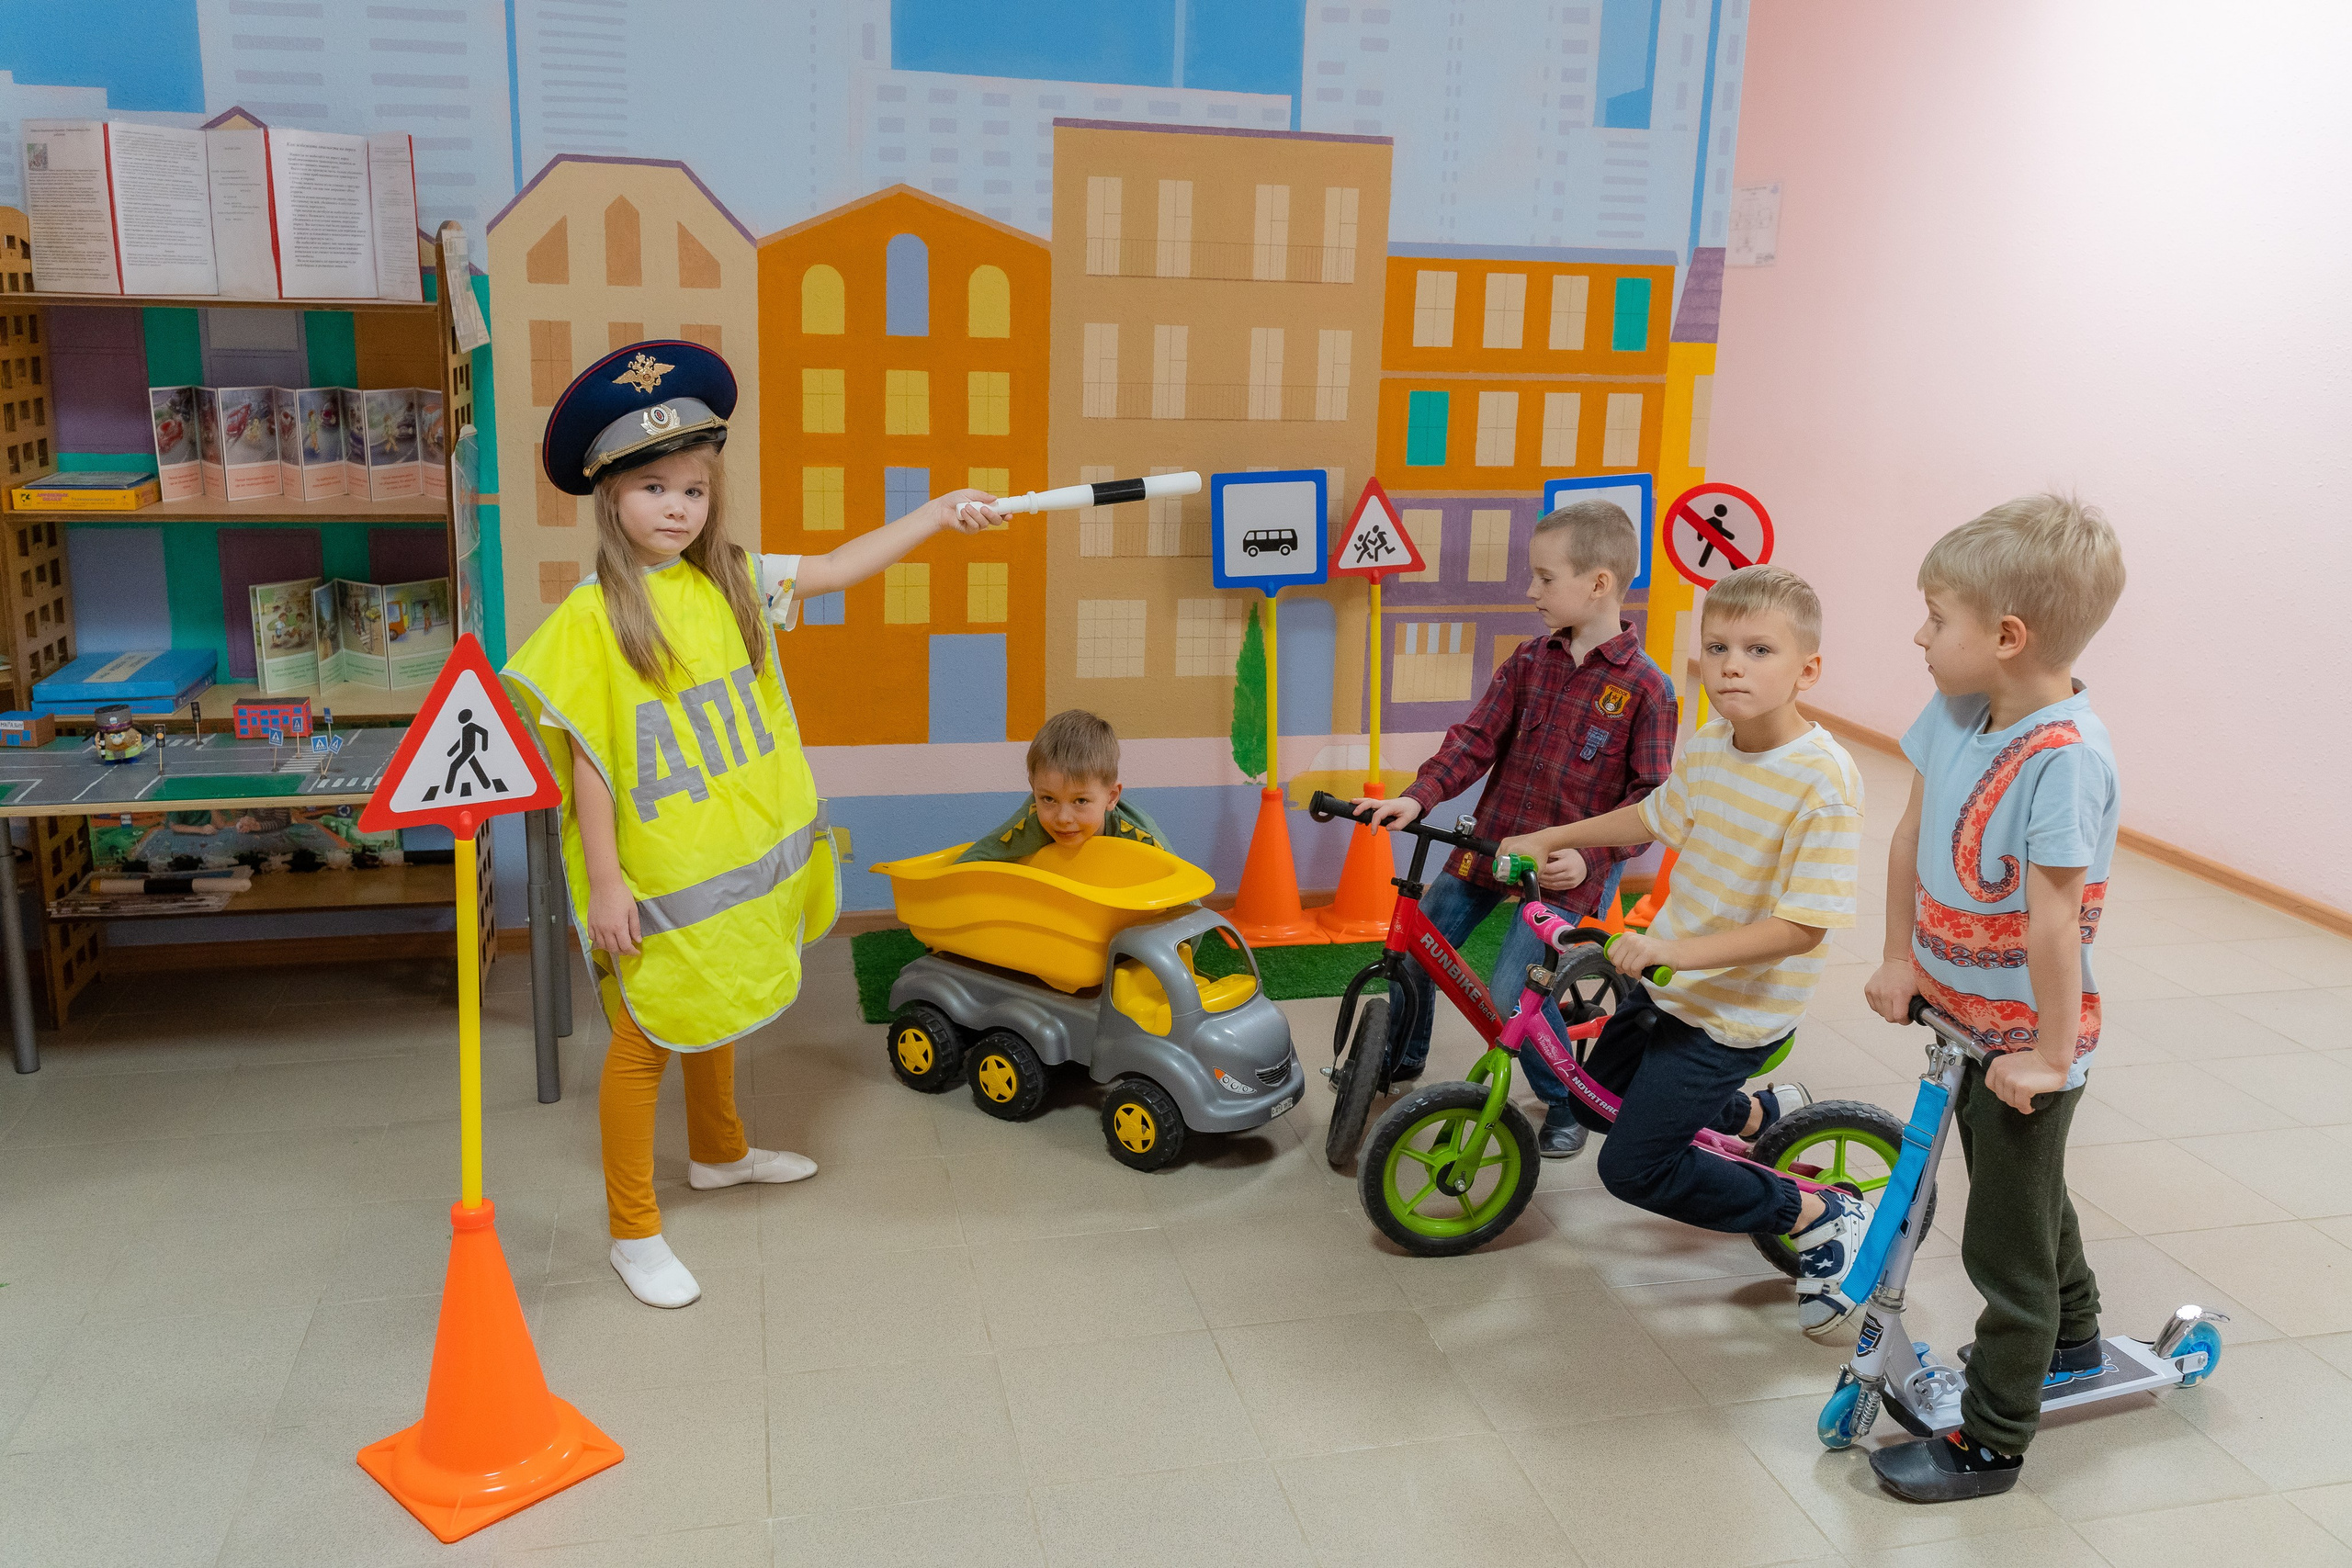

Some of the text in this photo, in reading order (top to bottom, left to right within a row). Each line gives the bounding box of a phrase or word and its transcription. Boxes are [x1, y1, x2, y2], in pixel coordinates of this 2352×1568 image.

[1419, 932, 1497, 1023] RUNBIKE beck
[1553, 1058, 1576, 1077] 12
[1572, 1076, 1619, 1116] NOVATRAC
